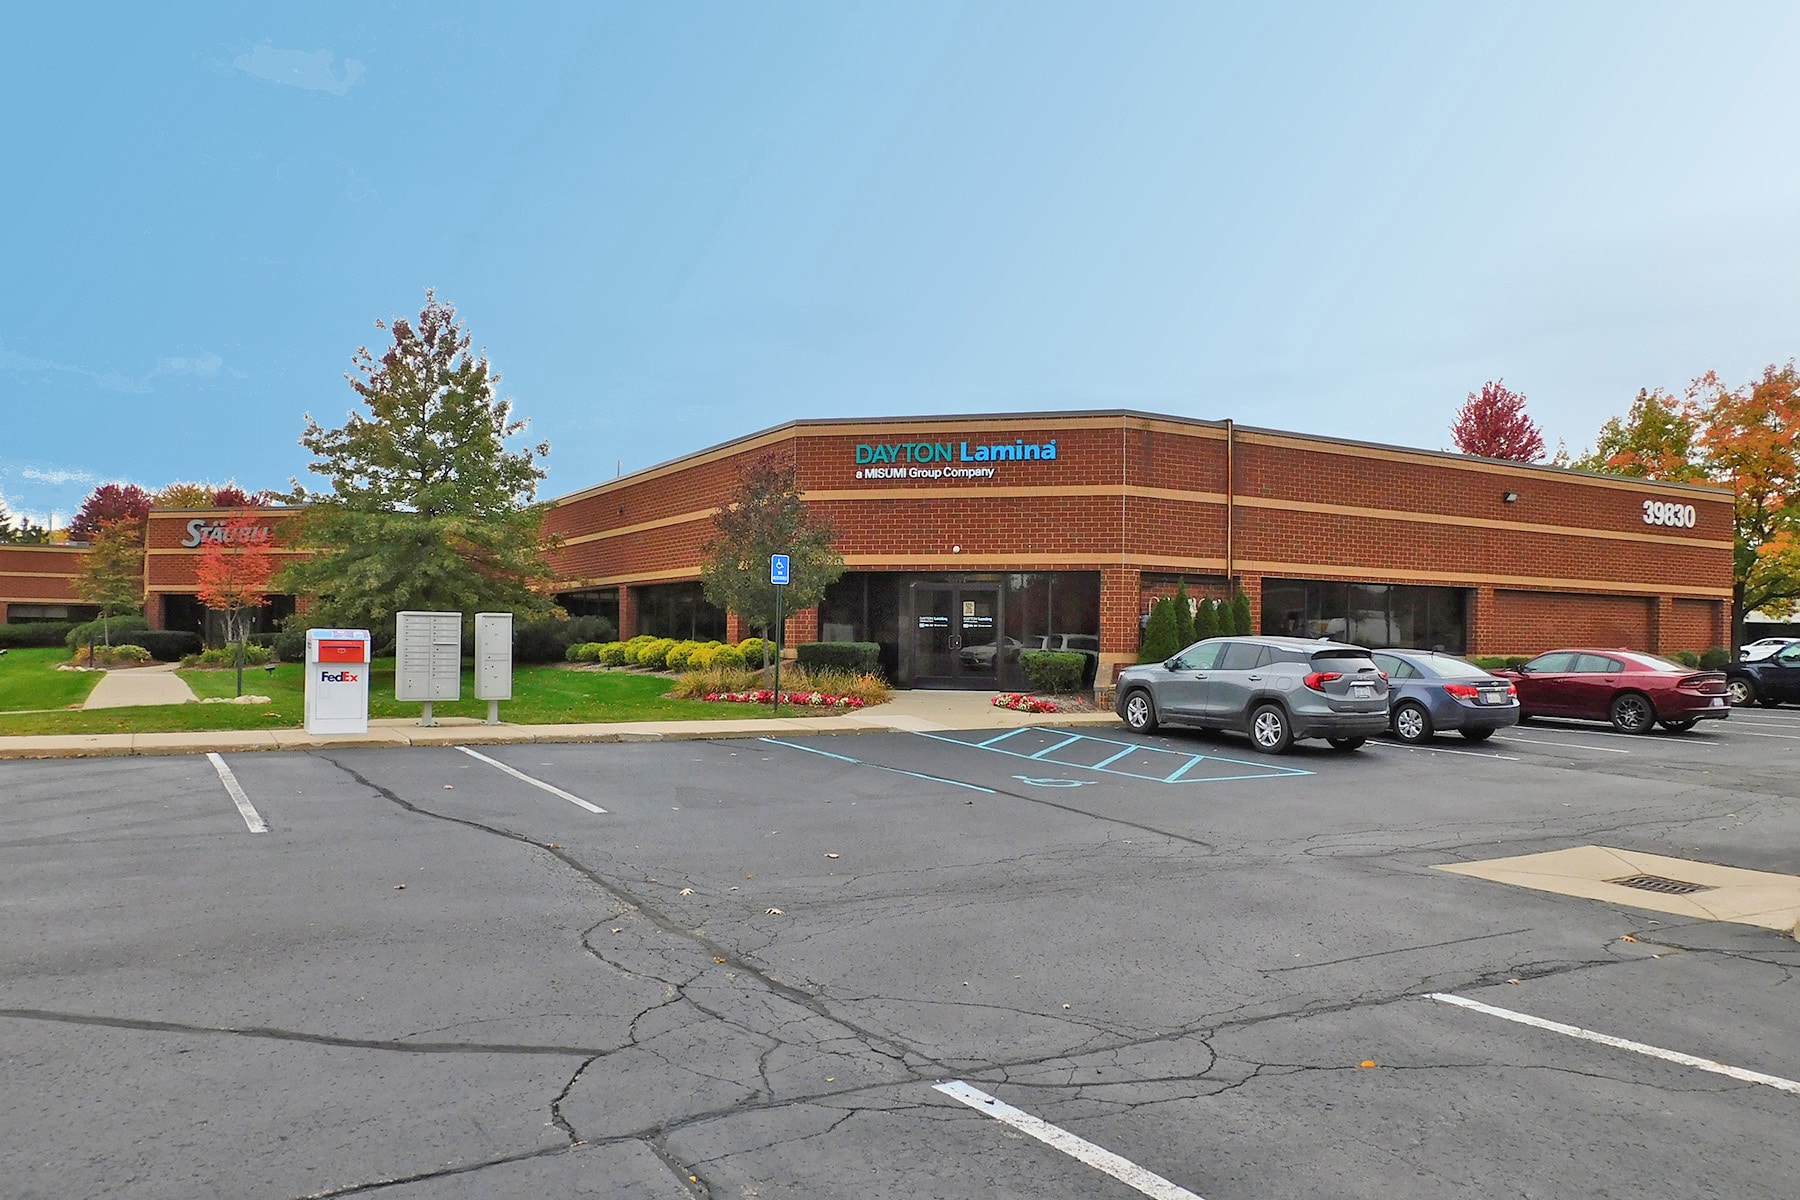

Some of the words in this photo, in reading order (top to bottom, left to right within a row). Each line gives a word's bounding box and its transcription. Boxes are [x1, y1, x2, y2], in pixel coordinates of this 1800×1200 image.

[855, 442, 953, 464] DAYTON
[960, 439, 1057, 462] Lamina
[856, 471, 863, 479] a
[864, 468, 907, 479] MISUMI
[908, 467, 942, 480] Group
[943, 466, 995, 479] Company
[1642, 500, 1696, 528] 39830
[321, 671, 358, 682] FedEx
